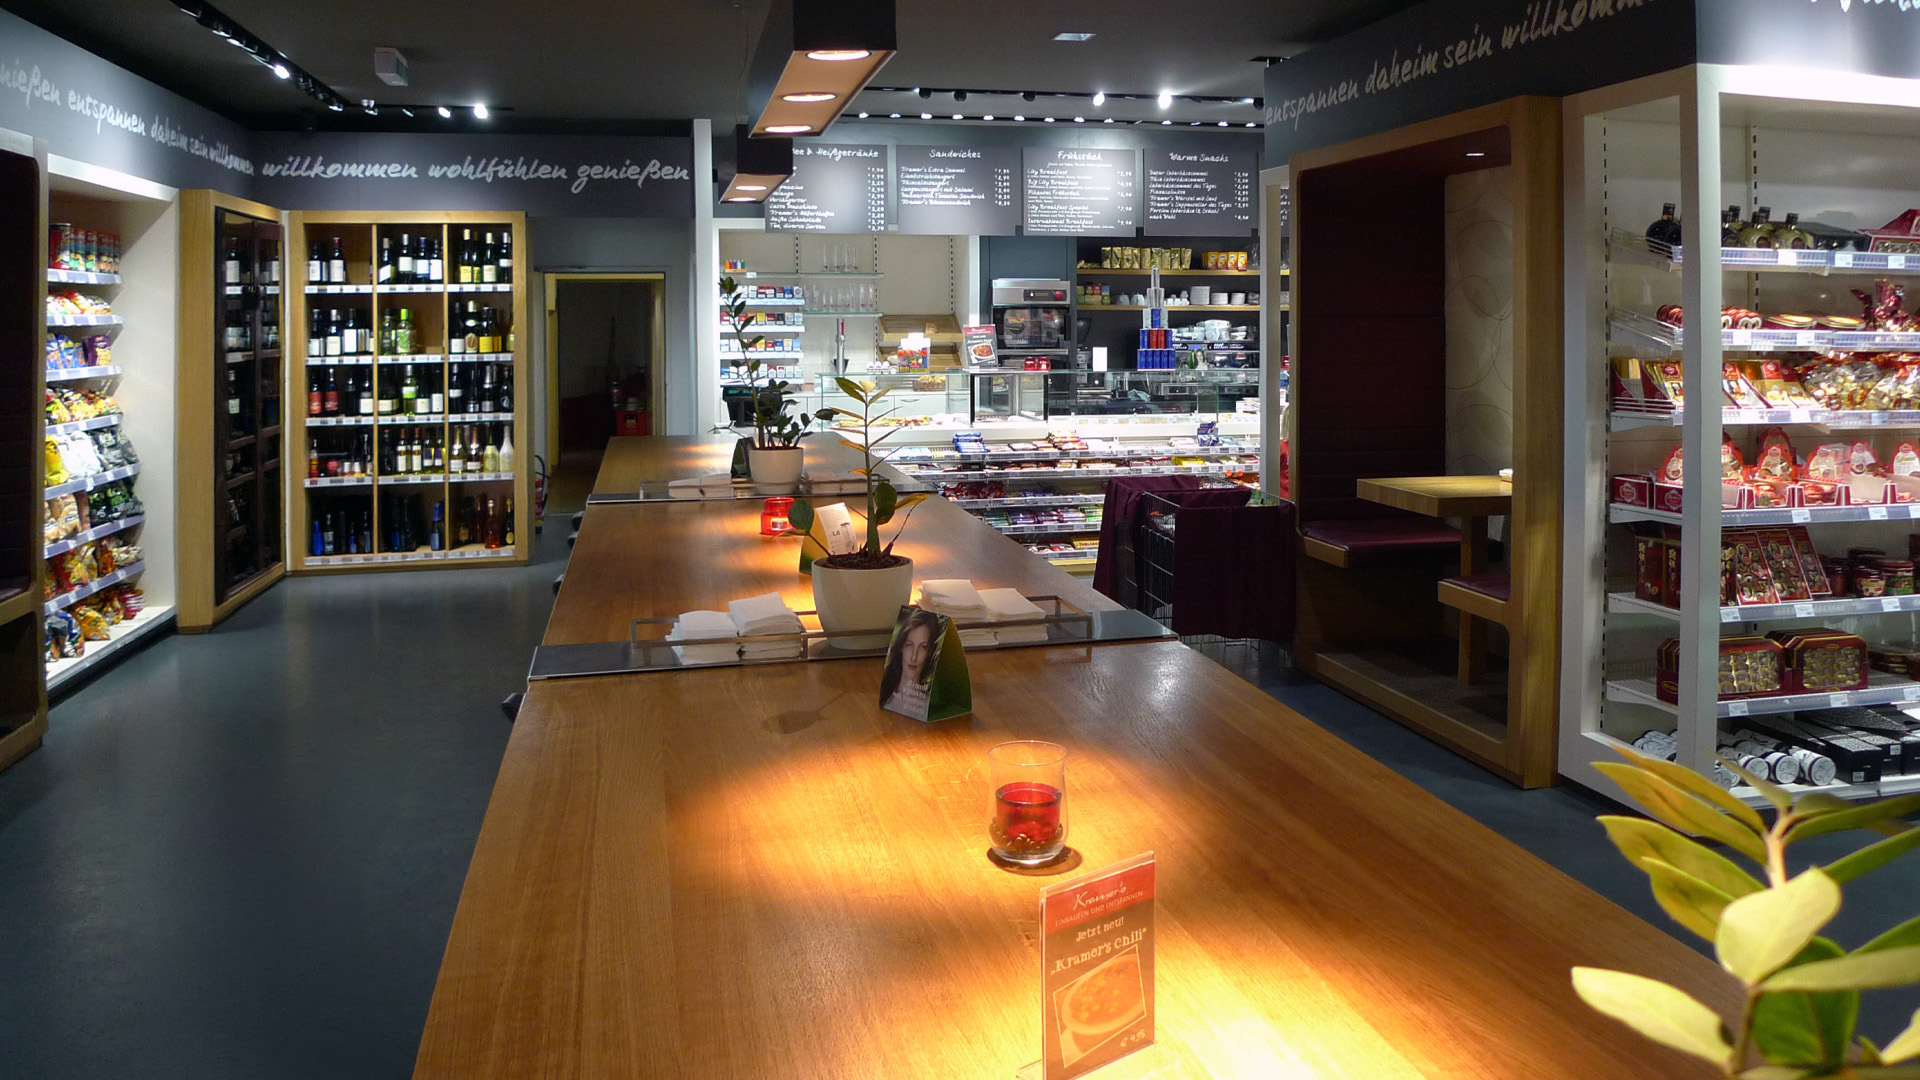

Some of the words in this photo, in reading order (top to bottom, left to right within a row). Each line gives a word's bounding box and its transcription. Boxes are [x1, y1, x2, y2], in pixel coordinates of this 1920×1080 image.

[1266, 79, 1359, 131] entspannen
[1365, 44, 1438, 94] daheim
[1443, 23, 1493, 69] sein
[0, 58, 61, 110] nießen
[68, 89, 146, 135] entspannen
[151, 115, 188, 152] daheim
[188, 135, 209, 160] sein
[209, 141, 254, 176] willkommen
[816, 148, 879, 161] Heißgetränke
[929, 149, 981, 159] Sandwiches
[1058, 151, 1103, 161] Frühstück
[1169, 153, 1197, 161] Warme
[1199, 153, 1229, 162] Snacks
[262, 155, 418, 179] willkommen
[428, 155, 568, 182] wohlfühlen
[577, 159, 690, 194] genießen
[1202, 183, 1217, 192] Tages
[1218, 201, 1232, 211] Tages
[1055, 908, 1090, 927] EINKAUFEN
[1090, 903, 1105, 915] UND
[1105, 890, 1143, 911] ENTSPANNEN
[1076, 924, 1101, 942] Jetzt
[1103, 916, 1124, 932] neu!
